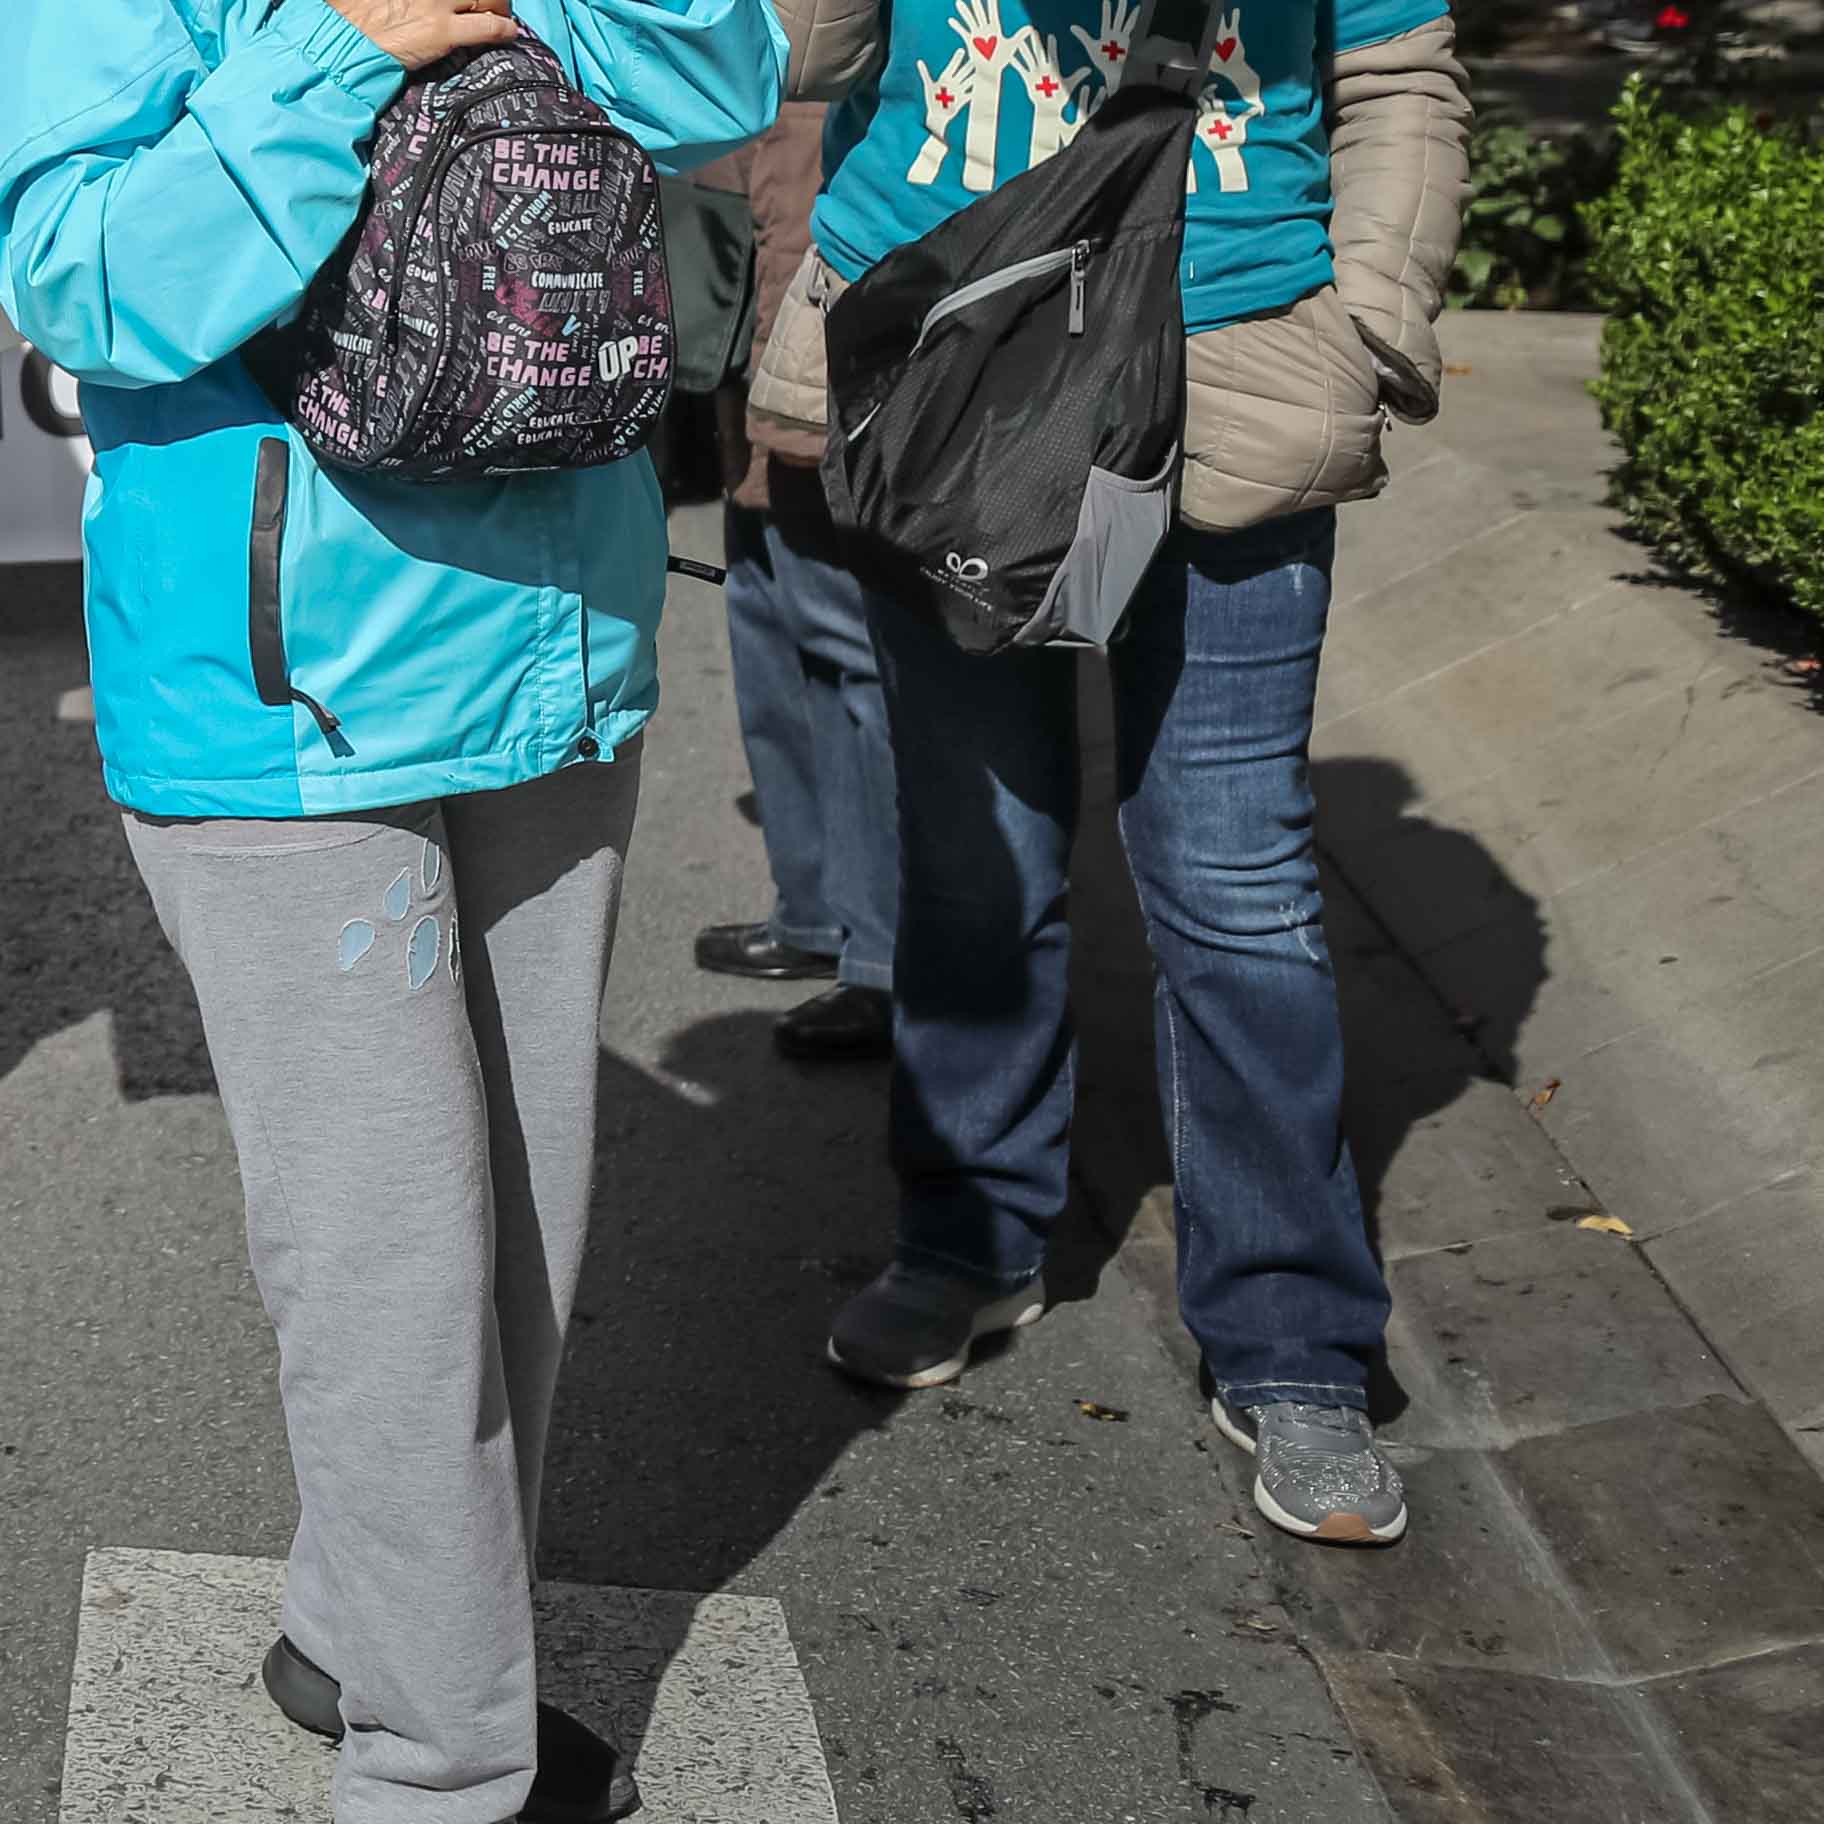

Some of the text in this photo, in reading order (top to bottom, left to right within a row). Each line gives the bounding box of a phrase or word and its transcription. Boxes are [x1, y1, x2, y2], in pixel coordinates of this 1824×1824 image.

[494, 138, 578, 165] BE THE
[493, 163, 600, 191] CHANGE
[548, 218, 593, 235] EDUCATE
[482, 265, 496, 291] FREE
[532, 271, 603, 289] COMMUNICATE
[487, 332, 570, 362] BE THE
[598, 335, 638, 382] UP
[638, 335, 662, 355] BE
[487, 356, 592, 387] CHANGE
[322, 384, 351, 418] THE
[298, 395, 360, 451] CHANGE
